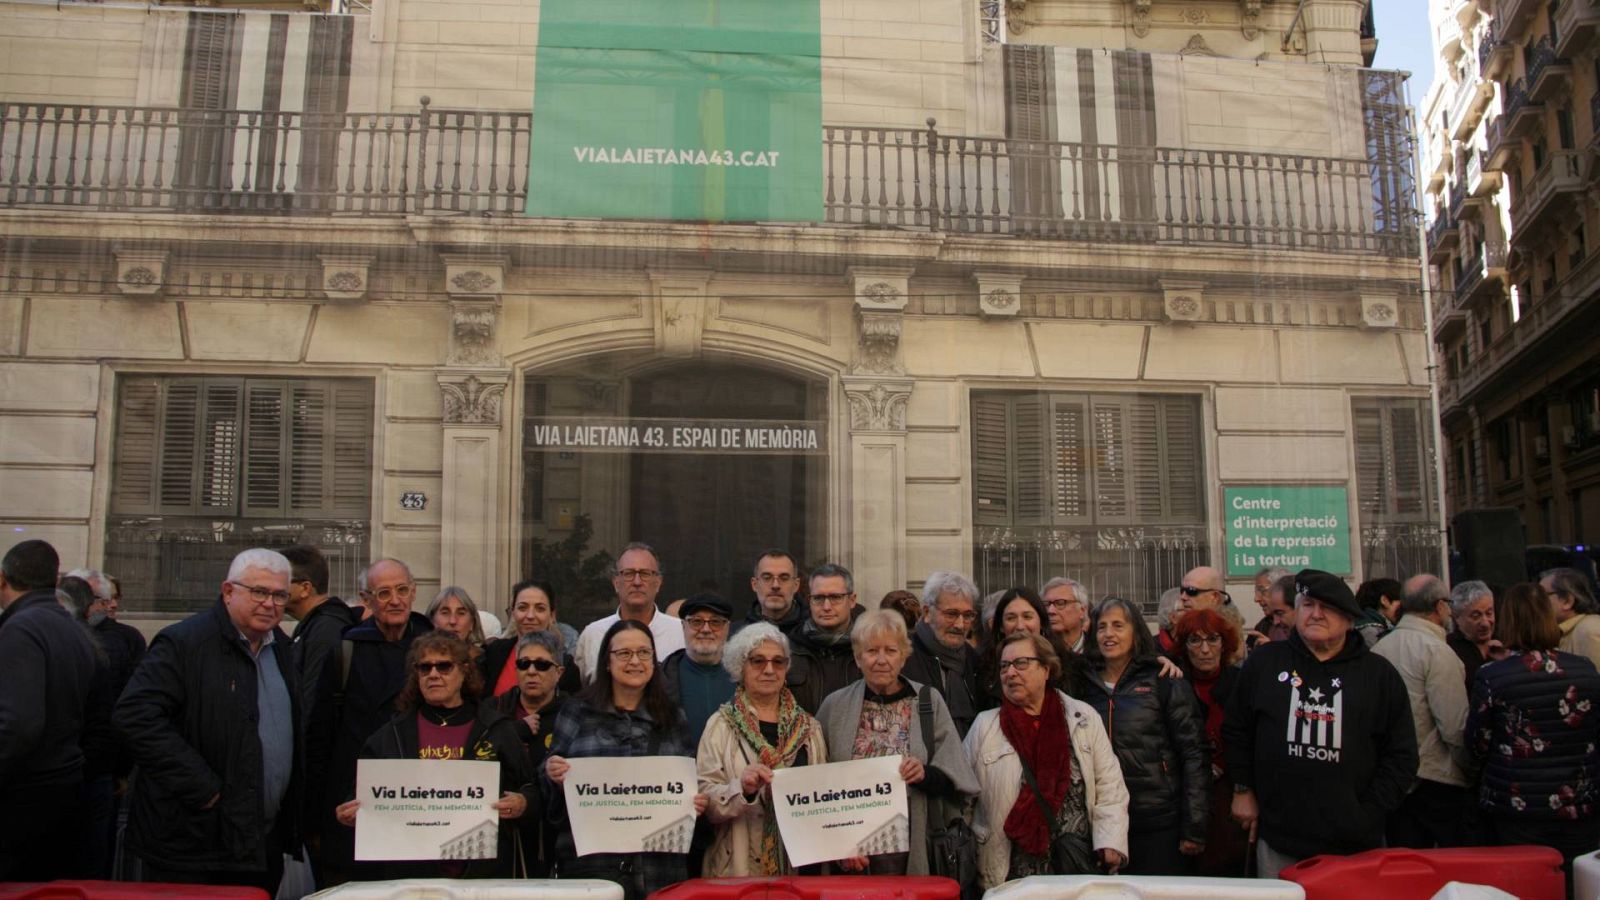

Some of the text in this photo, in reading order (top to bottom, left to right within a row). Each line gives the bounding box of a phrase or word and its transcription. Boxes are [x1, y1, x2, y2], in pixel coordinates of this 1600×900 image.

[574, 147, 780, 167] VIALAIETANA43.CAT
[534, 425, 818, 449] VIA LAIETANA 43. ESPAI DE MEMÒRIA
[404, 494, 424, 508] 43
[1232, 496, 1281, 510] Centre
[1233, 515, 1338, 531] d'interpretació
[1234, 534, 1336, 550] de la repressió
[1235, 554, 1310, 566] i la tortura
[1288, 744, 1340, 763] HI SOM
[372, 786, 485, 799] Via Laietana 43
[576, 782, 684, 796] Via Laietana 43
[786, 782, 892, 806] Via Laietana 43
[791, 810, 805, 818] FEM
[841, 804, 855, 812] FEM
